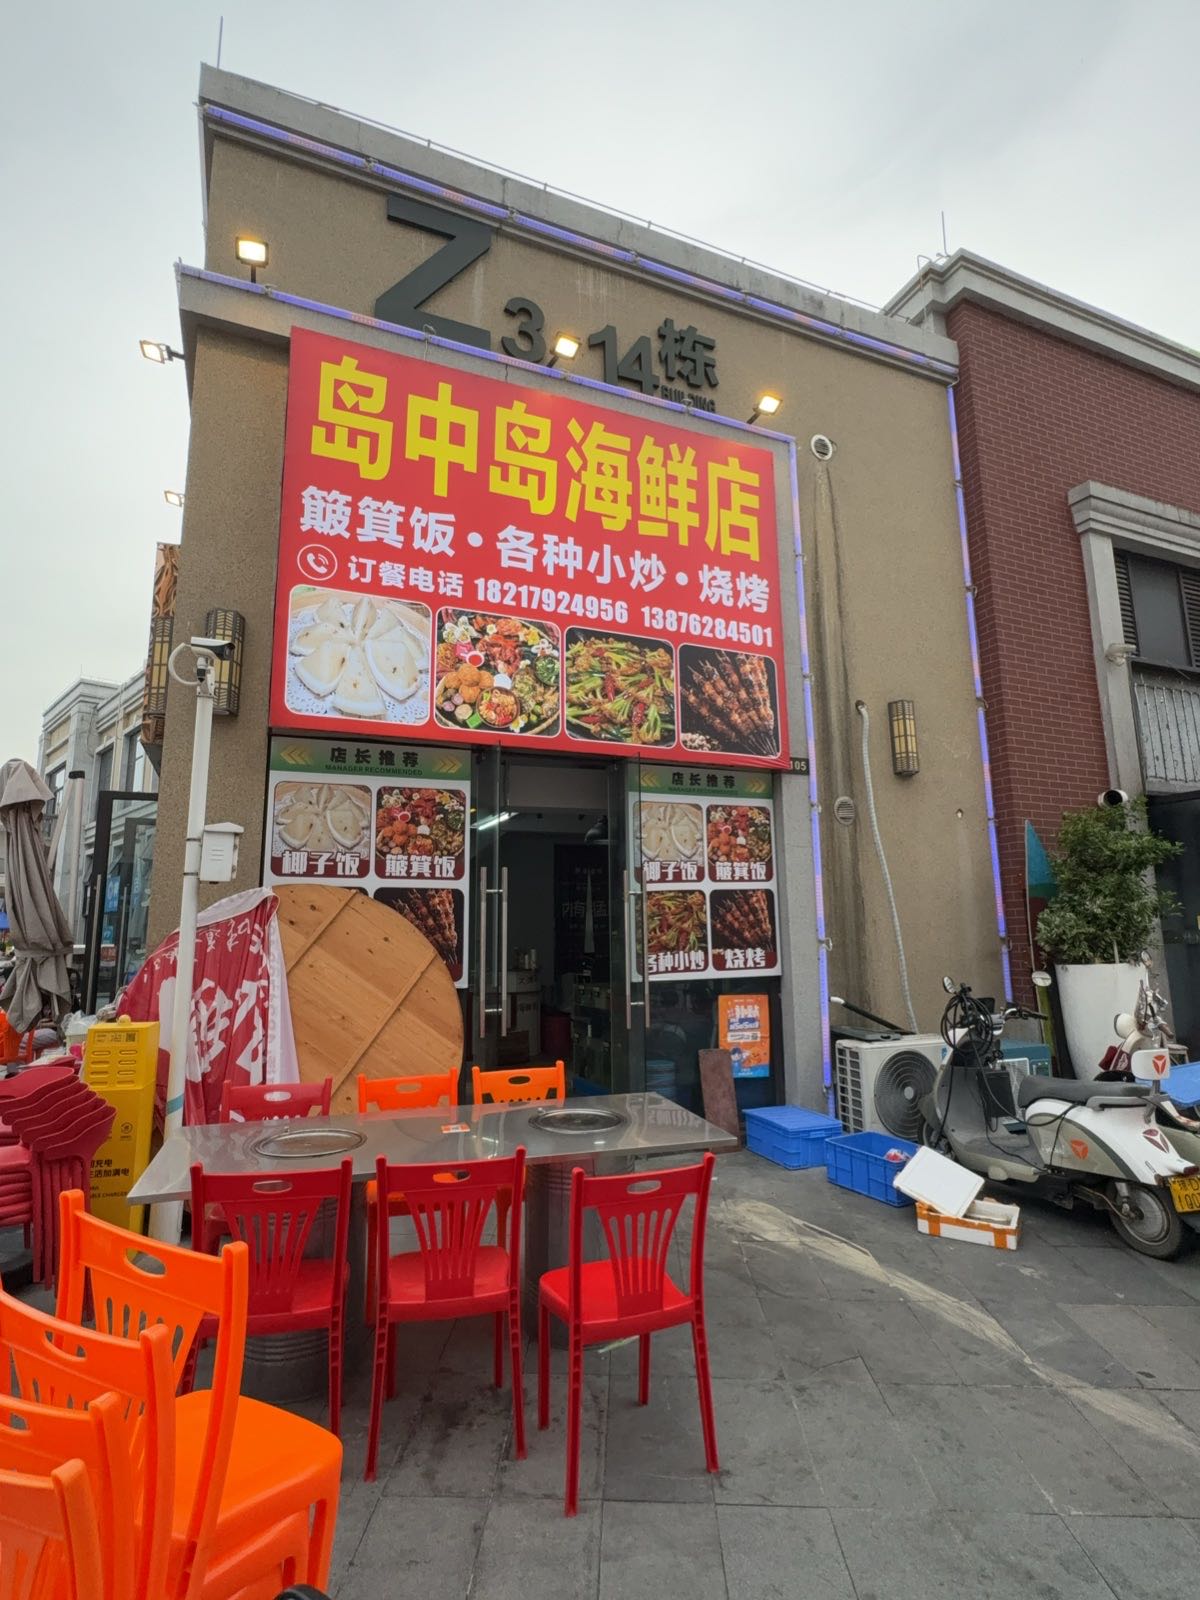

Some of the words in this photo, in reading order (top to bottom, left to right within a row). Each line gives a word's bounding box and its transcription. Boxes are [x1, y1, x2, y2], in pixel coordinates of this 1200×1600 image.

[310, 355, 762, 562] 岛中岛海鲜店
[348, 555, 463, 598] 订餐电话
[474, 578, 628, 624] 18217924956
[641, 606, 773, 647] 13876284501
[329, 746, 419, 768] 店长推荐
[325, 764, 364, 772] MANAGER
[365, 766, 423, 776] RECOMMENDED
[672, 772, 736, 789] 店长推荐
[281, 850, 360, 876] 椰子饭
[385, 854, 456, 878] 簸箕饭
[643, 861, 698, 881] 椰子饭
[716, 861, 766, 881] 簸箕饭
[724, 948, 766, 969] 烧烤
